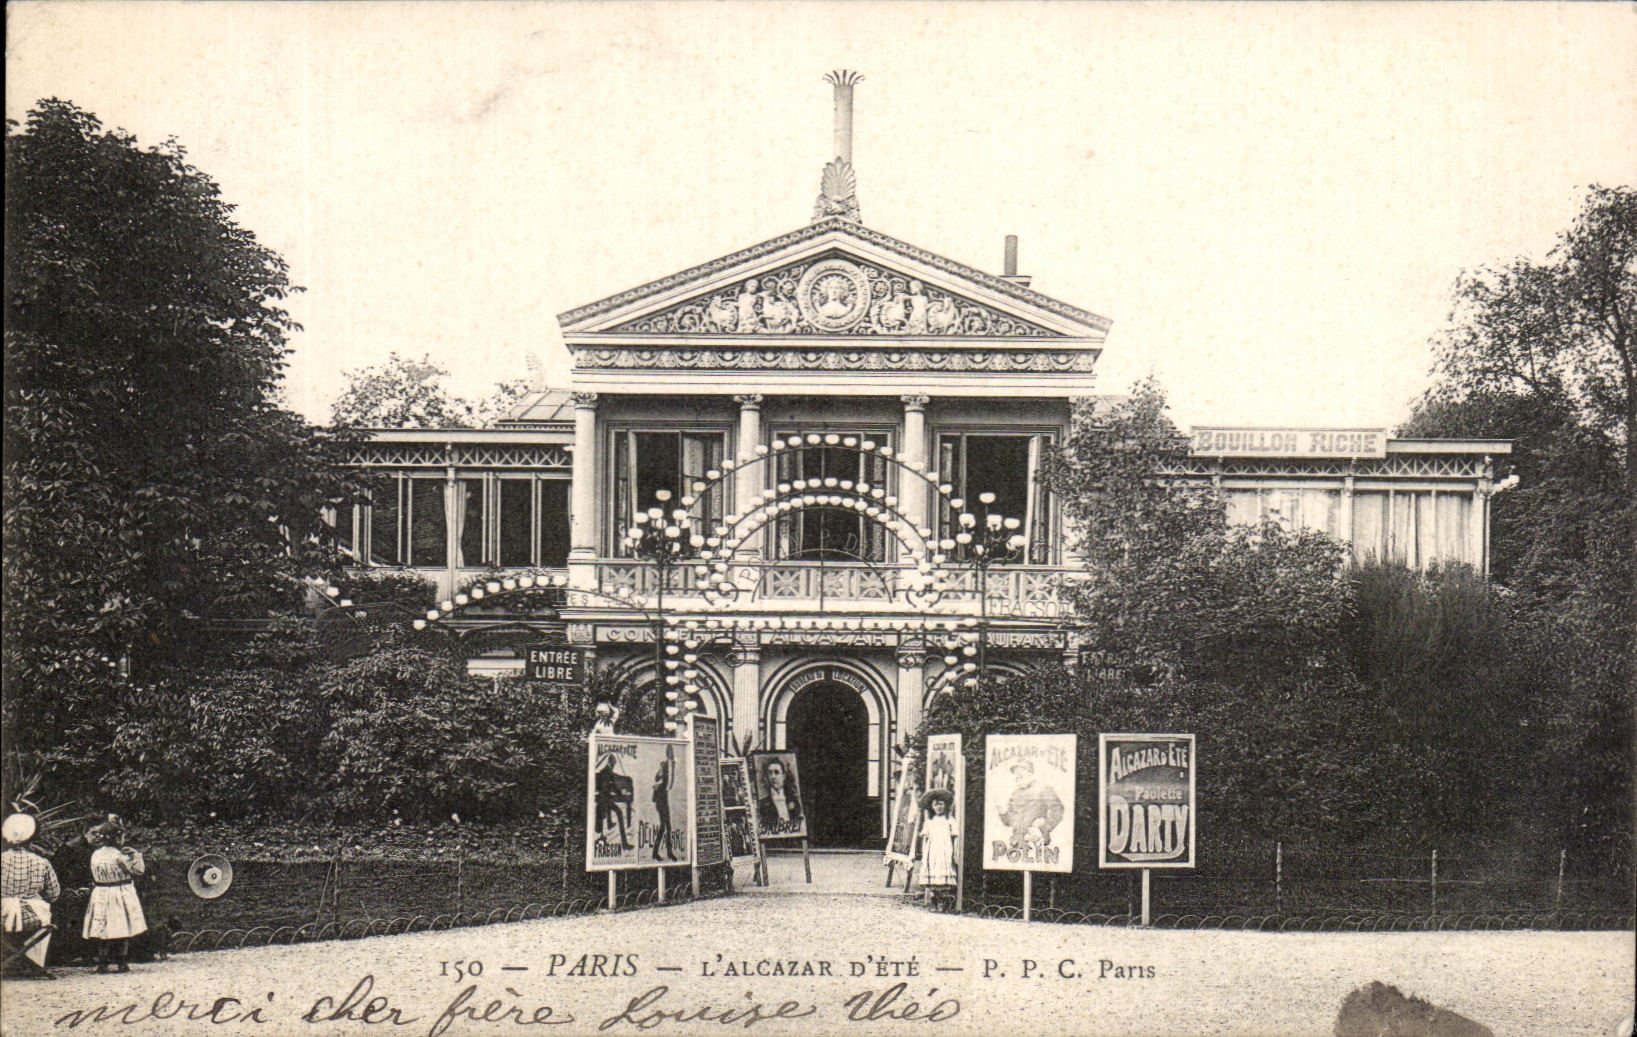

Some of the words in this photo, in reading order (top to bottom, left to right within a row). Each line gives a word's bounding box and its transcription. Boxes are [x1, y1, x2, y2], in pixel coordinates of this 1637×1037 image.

[1196, 431, 1297, 451] BOUILLON
[1308, 432, 1377, 453] RICHE
[530, 650, 578, 665] ENTRÉE
[535, 666, 574, 680] LIBRE
[1133, 786, 1183, 801] Paulette
[1109, 795, 1189, 860] DARTY
[992, 840, 1060, 865] POLIN
[54, 990, 275, 1027] merci
[302, 974, 420, 1025] cher
[428, 984, 576, 1037] frère
[598, 985, 817, 1030] Louise
